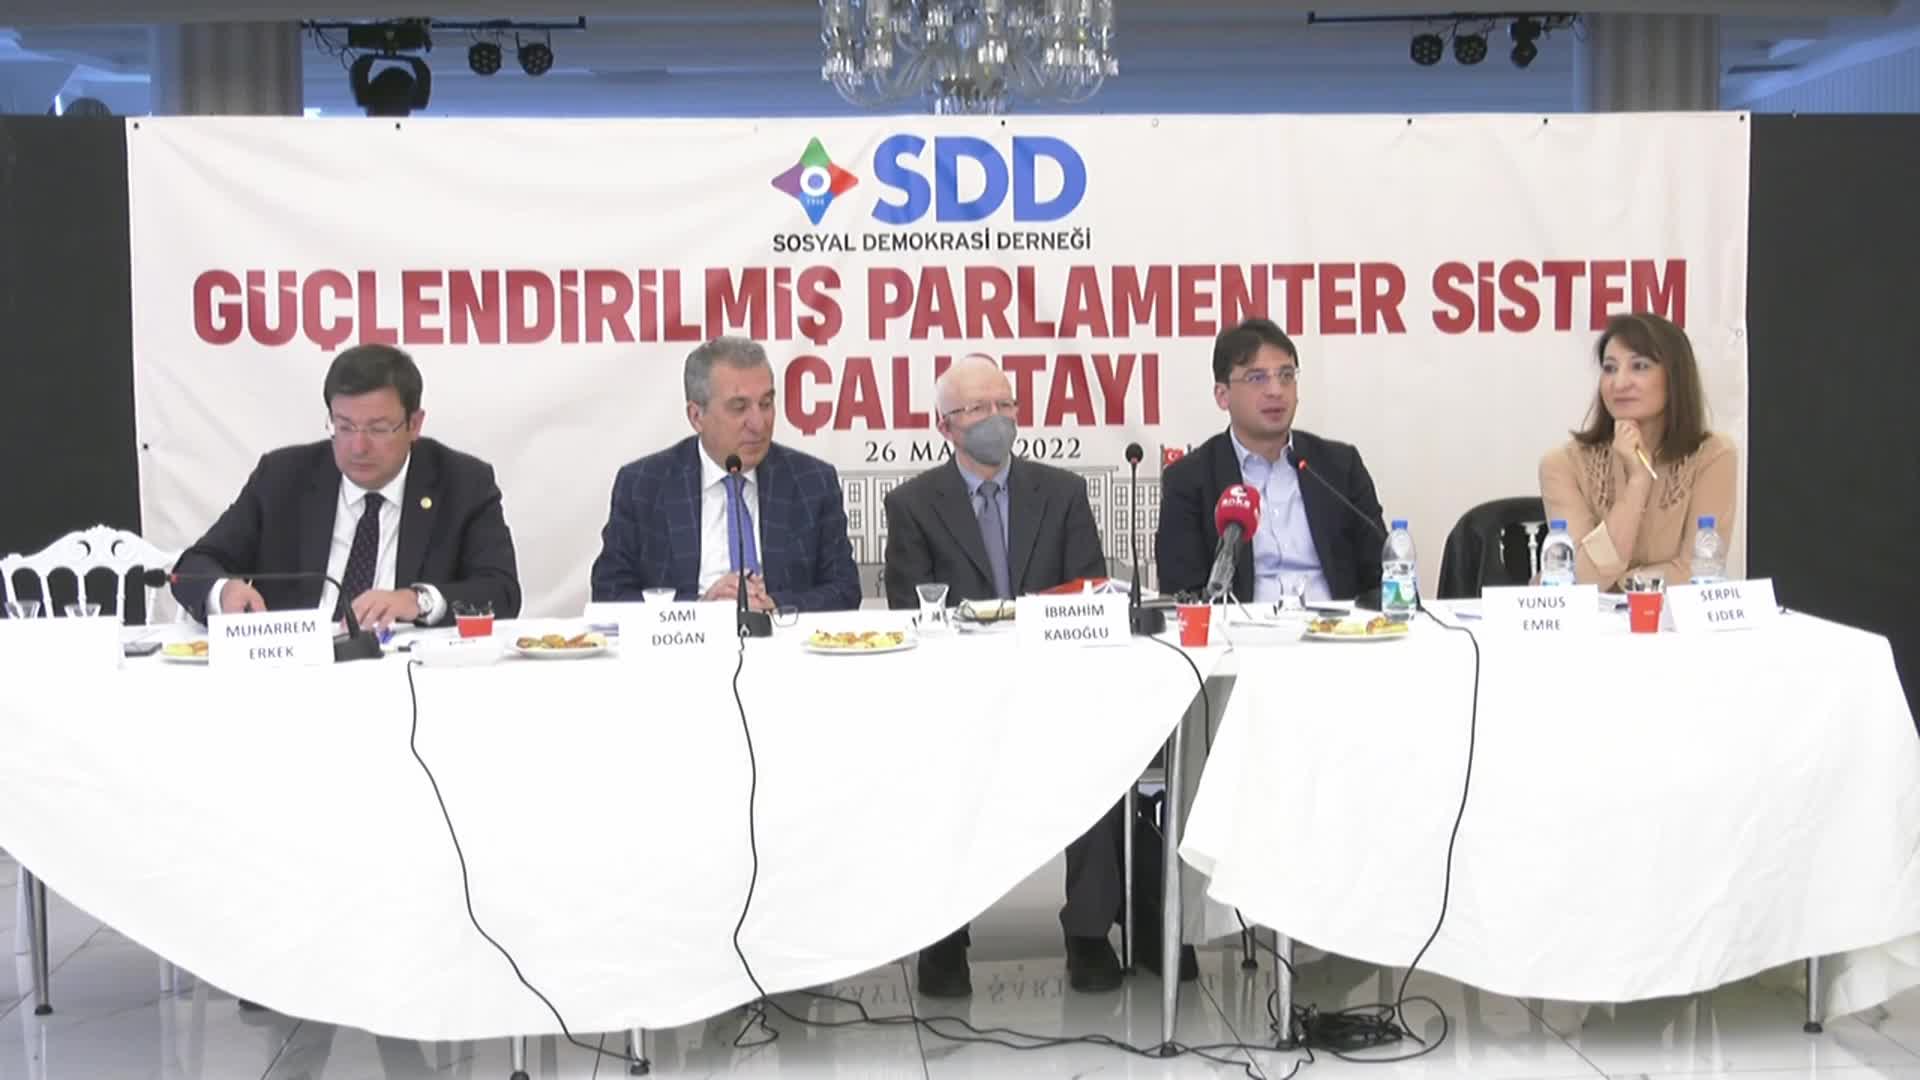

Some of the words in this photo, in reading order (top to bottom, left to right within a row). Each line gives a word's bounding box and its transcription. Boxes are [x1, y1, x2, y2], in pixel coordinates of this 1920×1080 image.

[871, 133, 1087, 225] SDD
[773, 233, 857, 253] SOSYAL
[862, 227, 990, 251] DEMOKRASİ
[997, 226, 1091, 250] DERNEĞİ
[192, 265, 843, 352] GÜÇLENDİRİLMİŞ
[869, 262, 1406, 341] PARLAMENTER
[1433, 258, 1687, 334] SİSTEM
[784, 352, 1160, 436] ÇALTAYI
[865, 441, 897, 463] 26
[909, 440, 954, 463] MA
[1018, 437, 1082, 461] 2022
[1044, 603, 1106, 619] İBRAHİM
[1517, 596, 1567, 609] YUNUS
[1707, 608, 1746, 623] EJDER
[225, 620, 317, 639] MUHARREM
[1043, 625, 1109, 641] KABOĞLU
[1523, 619, 1561, 631] EMRE
[651, 630, 706, 647] DOĞAN
[249, 645, 295, 661] ERKEK
